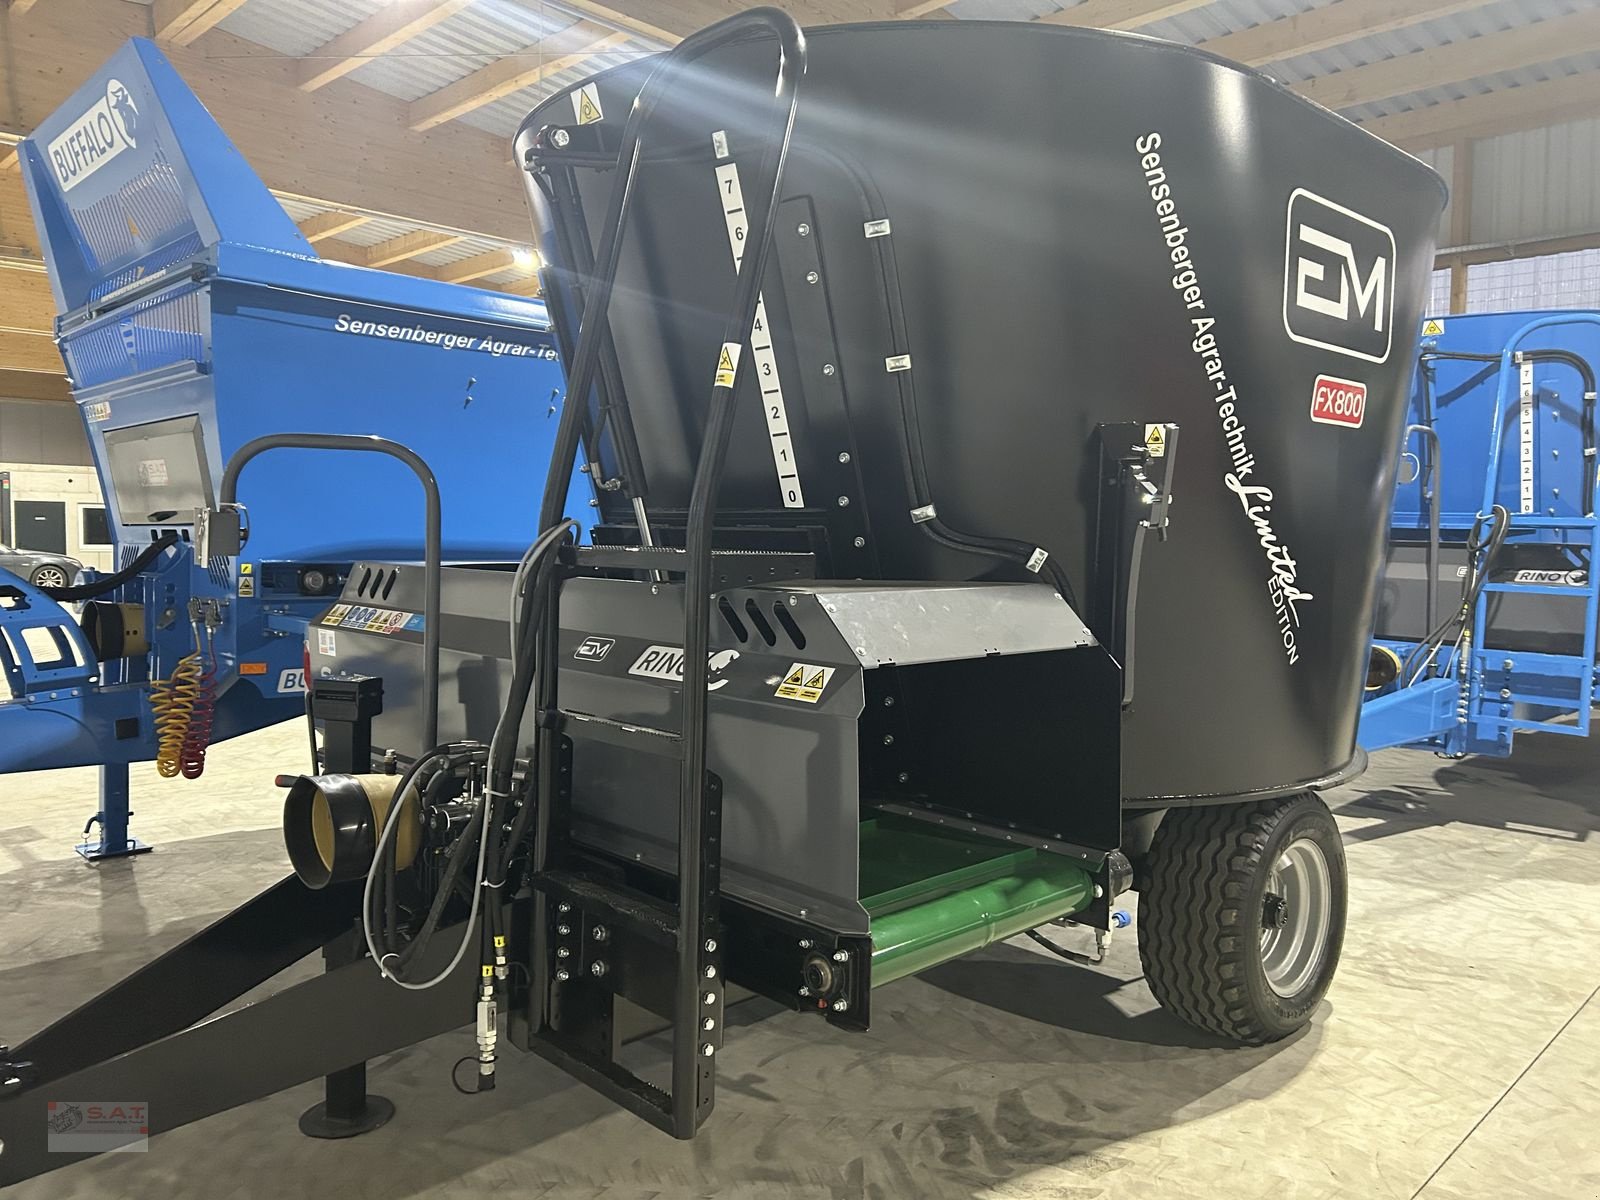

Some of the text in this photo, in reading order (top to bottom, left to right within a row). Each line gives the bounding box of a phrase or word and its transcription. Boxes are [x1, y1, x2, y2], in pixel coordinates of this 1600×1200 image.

[53, 111, 114, 184] BUFFALO
[724, 179, 733, 194] 7
[735, 226, 744, 241] 6
[1136, 132, 1255, 480] Sensenberger Agrar-Technik
[334, 314, 478, 350] Sensenberger
[754, 317, 763, 332] 4
[762, 363, 771, 376] 3
[1314, 386, 1363, 418] FX800
[771, 406, 780, 419] 2
[780, 449, 788, 461] 1
[788, 490, 797, 502] 0
[1224, 472, 1314, 628] Limited
[1519, 572, 1561, 581] RINO
[1267, 574, 1300, 665] EDITION
